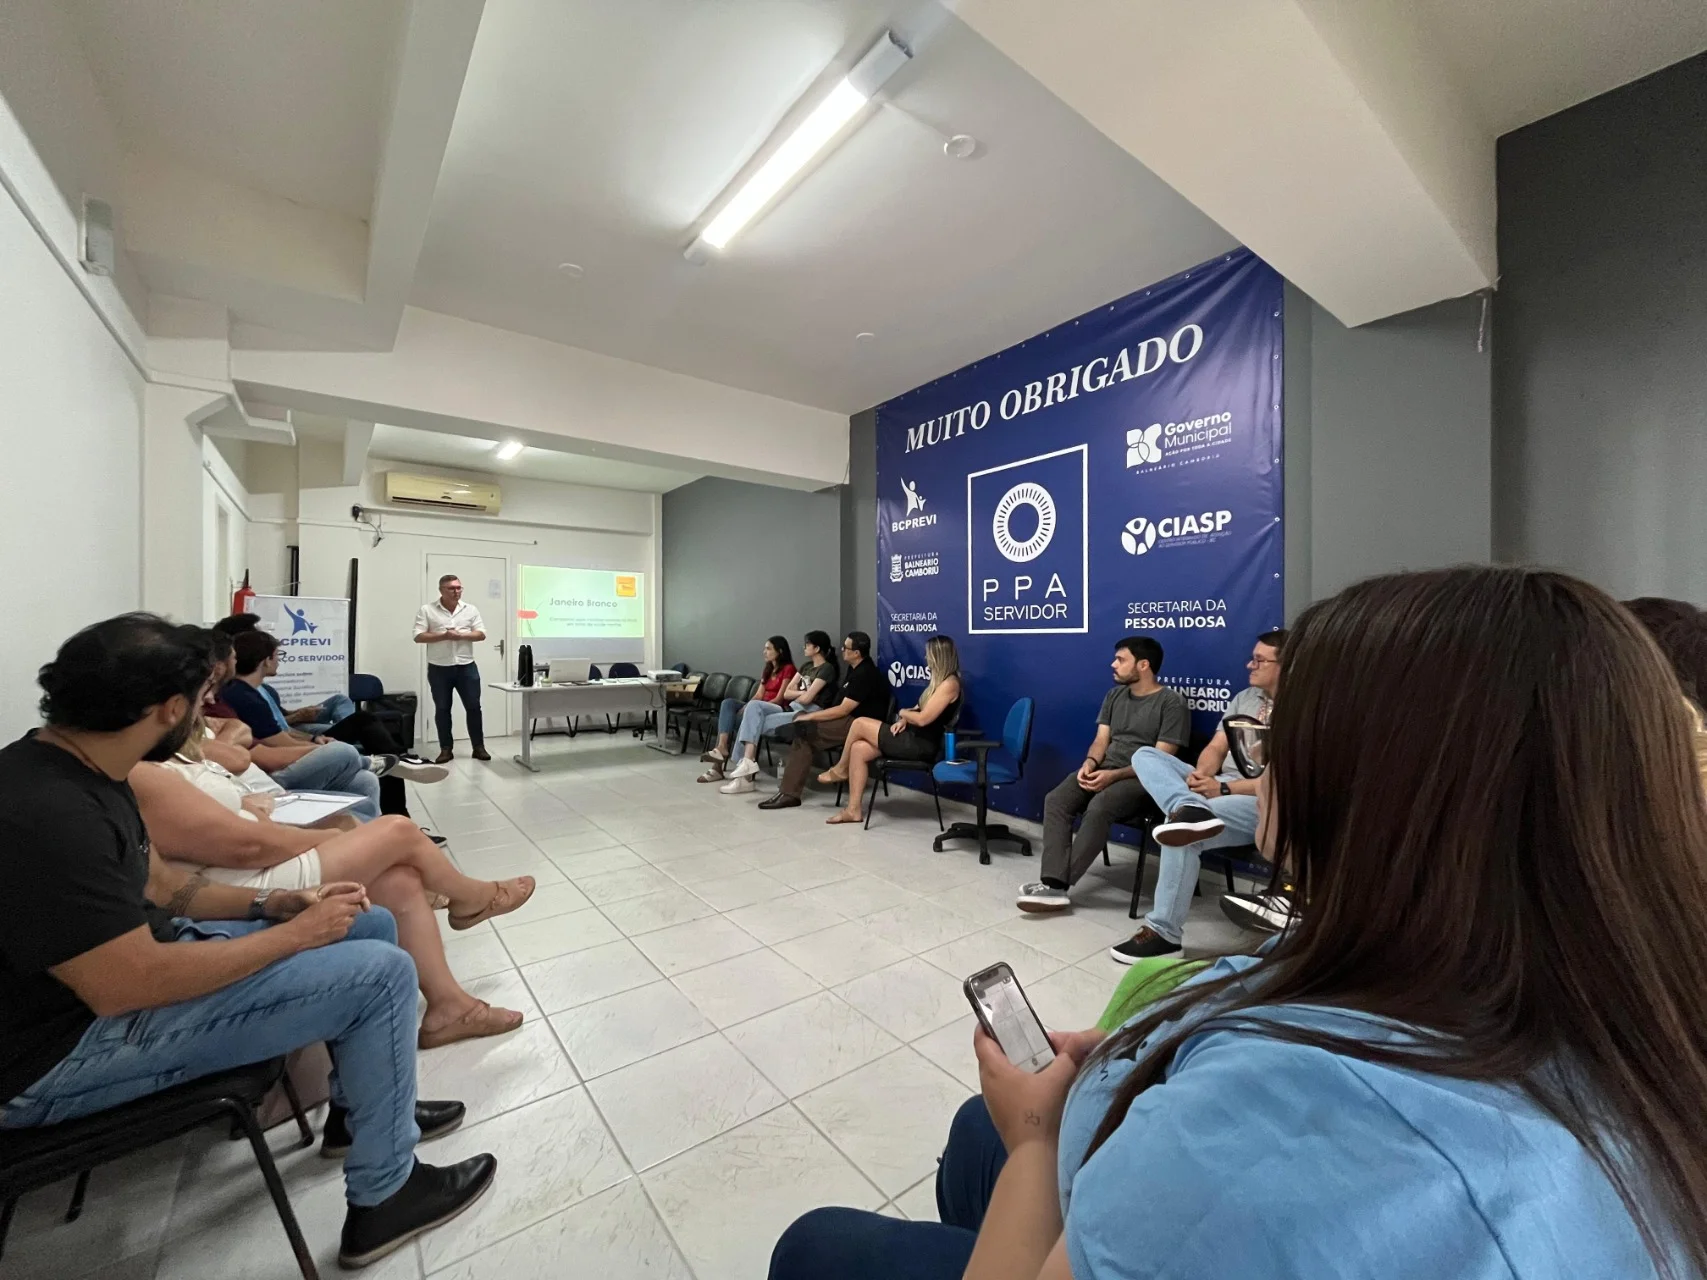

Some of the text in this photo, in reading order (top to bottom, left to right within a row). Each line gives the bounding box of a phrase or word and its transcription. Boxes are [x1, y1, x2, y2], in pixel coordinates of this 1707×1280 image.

[905, 324, 1204, 454] MUITO OBRIGADO
[1164, 412, 1232, 436] Governo
[1164, 422, 1232, 448] Municipal
[891, 514, 937, 532] BCPREVI
[1158, 510, 1232, 538] CIASP
[549, 597, 618, 608] Janeiro Branco
[1127, 599, 1227, 614] SECRETARIA DA
[890, 612, 938, 621] SECRETARIA DA
[983, 603, 1067, 621] SERVIDOR
[889, 623, 938, 632] PESSOA IDOSA
[1124, 616, 1226, 629] PESSOA IDOSA
[280, 638, 331, 646] CPREVI
[905, 664, 931, 680] CIAS
[1157, 676, 1231, 685] PREFEITURA
